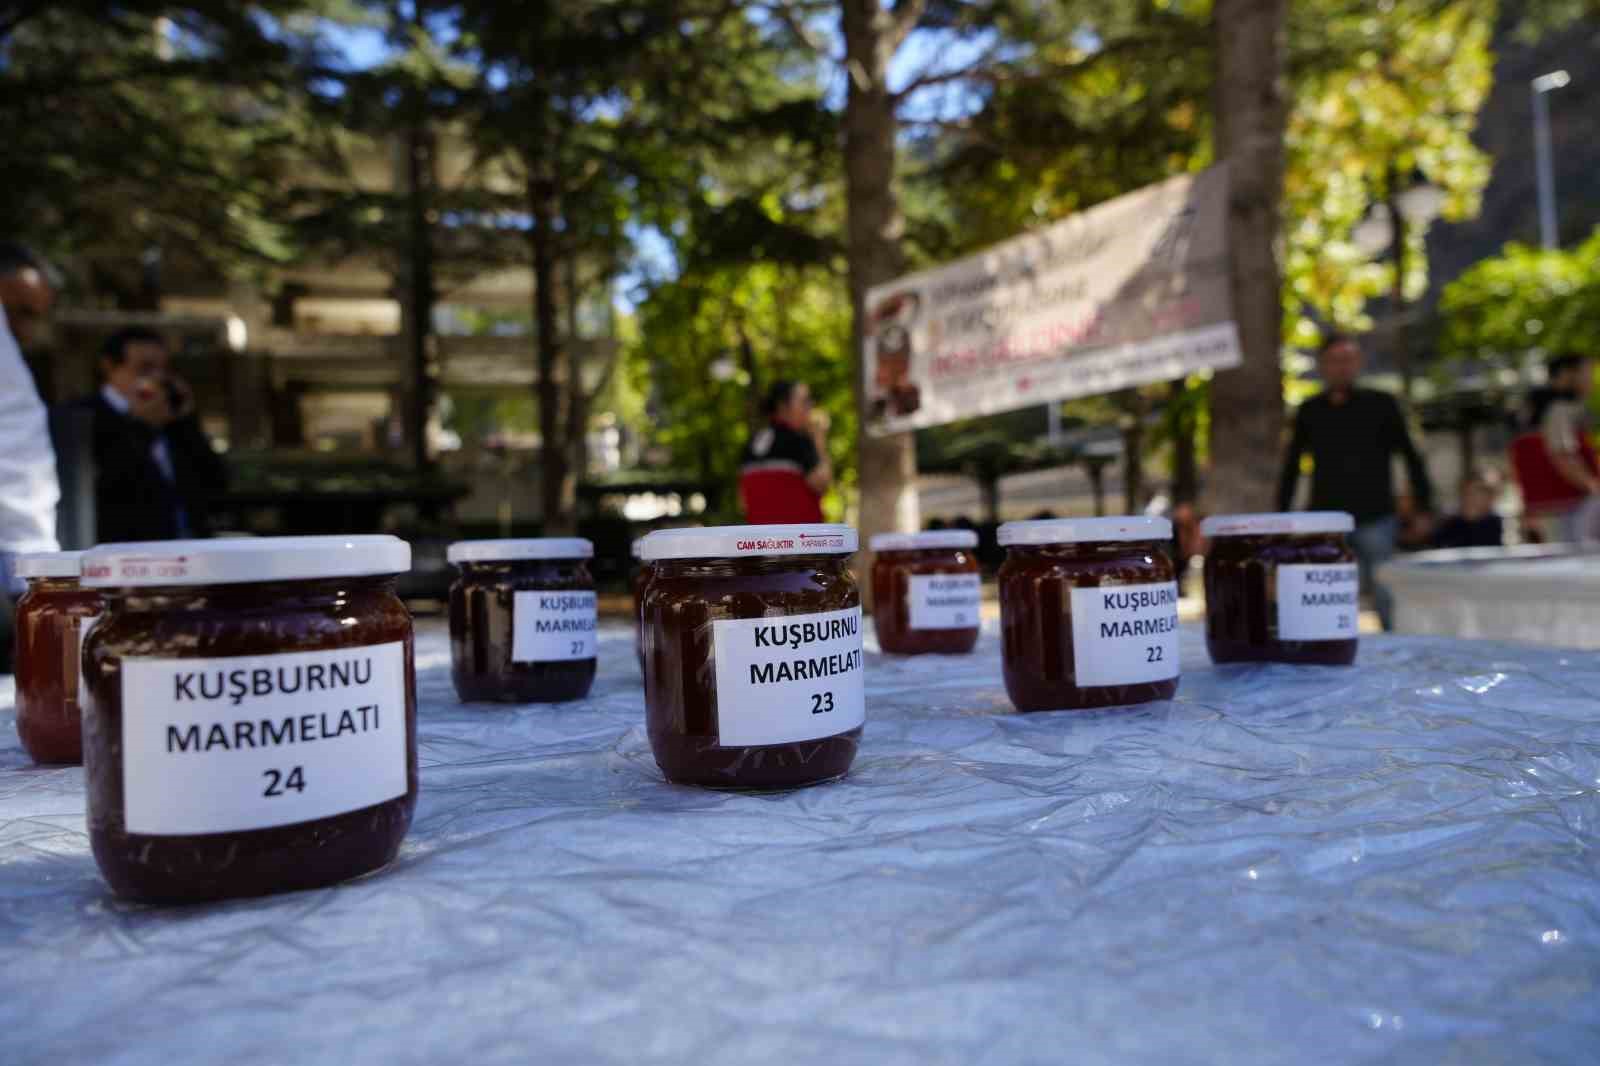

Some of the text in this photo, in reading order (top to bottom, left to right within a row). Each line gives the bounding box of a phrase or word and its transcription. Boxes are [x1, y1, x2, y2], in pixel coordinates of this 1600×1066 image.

[737, 540, 755, 551] CAM
[571, 640, 585, 655] 27
[754, 615, 857, 650] KUŞBURNU
[750, 648, 861, 684] MARMELATI
[1146, 646, 1163, 662] 22
[174, 658, 372, 705] KUŞBURNU
[811, 691, 834, 714] 23
[166, 704, 380, 753] MARMELATI
[262, 766, 306, 797] 24
